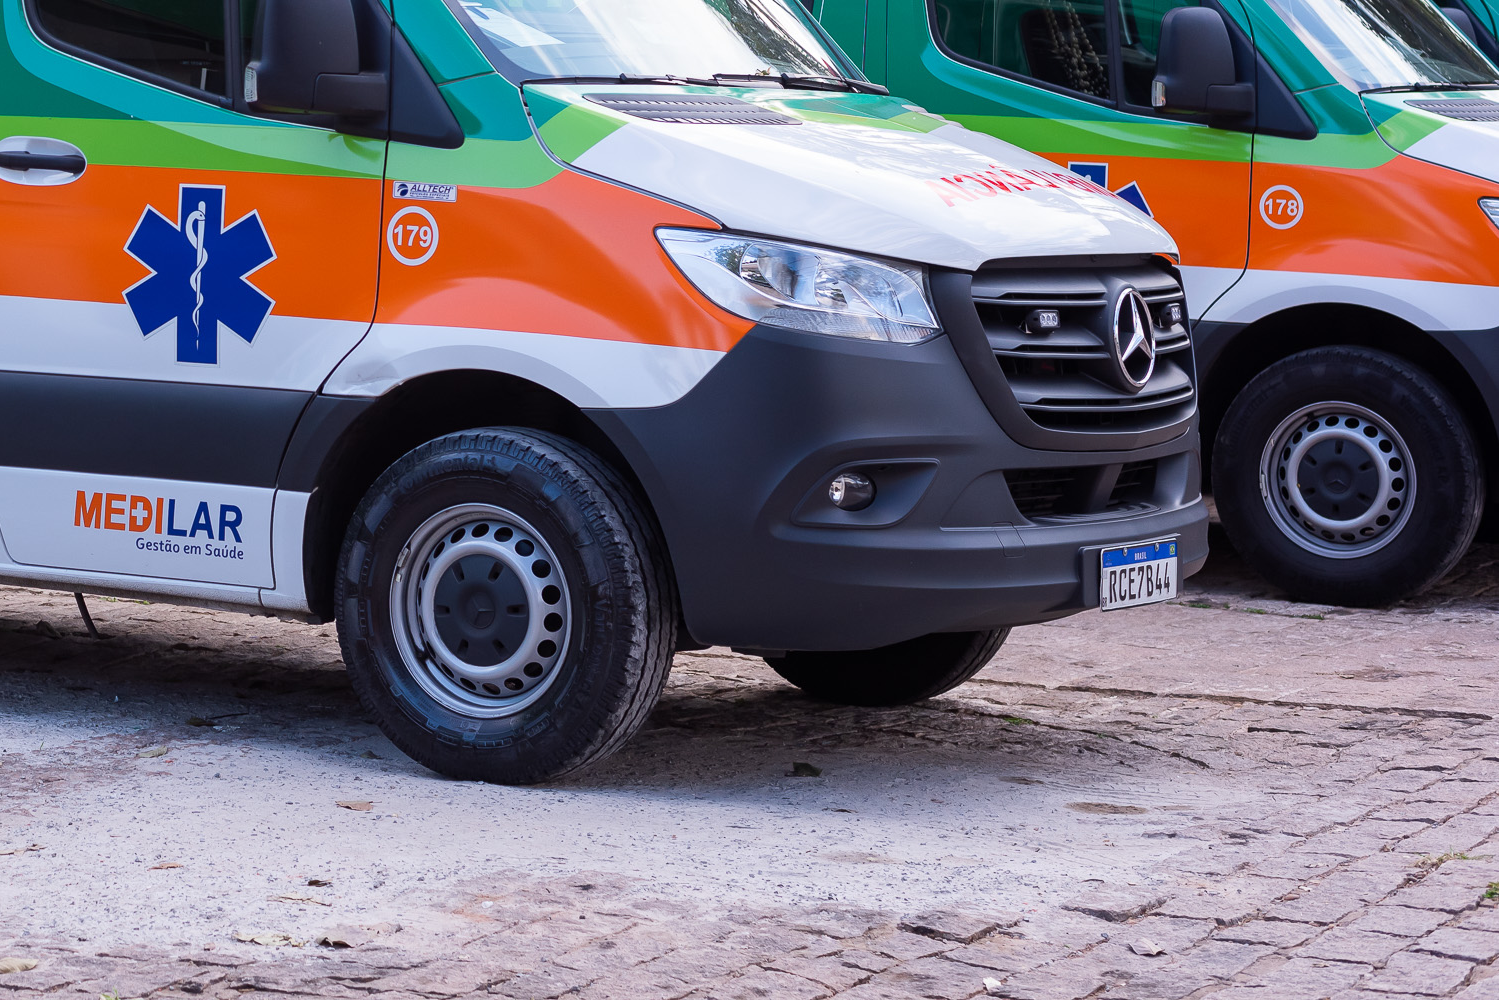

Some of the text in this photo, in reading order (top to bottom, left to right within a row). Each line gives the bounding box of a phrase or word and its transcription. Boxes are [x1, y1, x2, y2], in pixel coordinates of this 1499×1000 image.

[410, 184, 452, 194] ALLTECH
[1265, 198, 1298, 217] 178
[393, 224, 432, 248] 179
[74, 490, 243, 543] MEDILAR
[135, 537, 244, 560] Gestão em Saúde
[1134, 551, 1148, 561] BRASIL
[1109, 561, 1171, 604] RCE7B44
